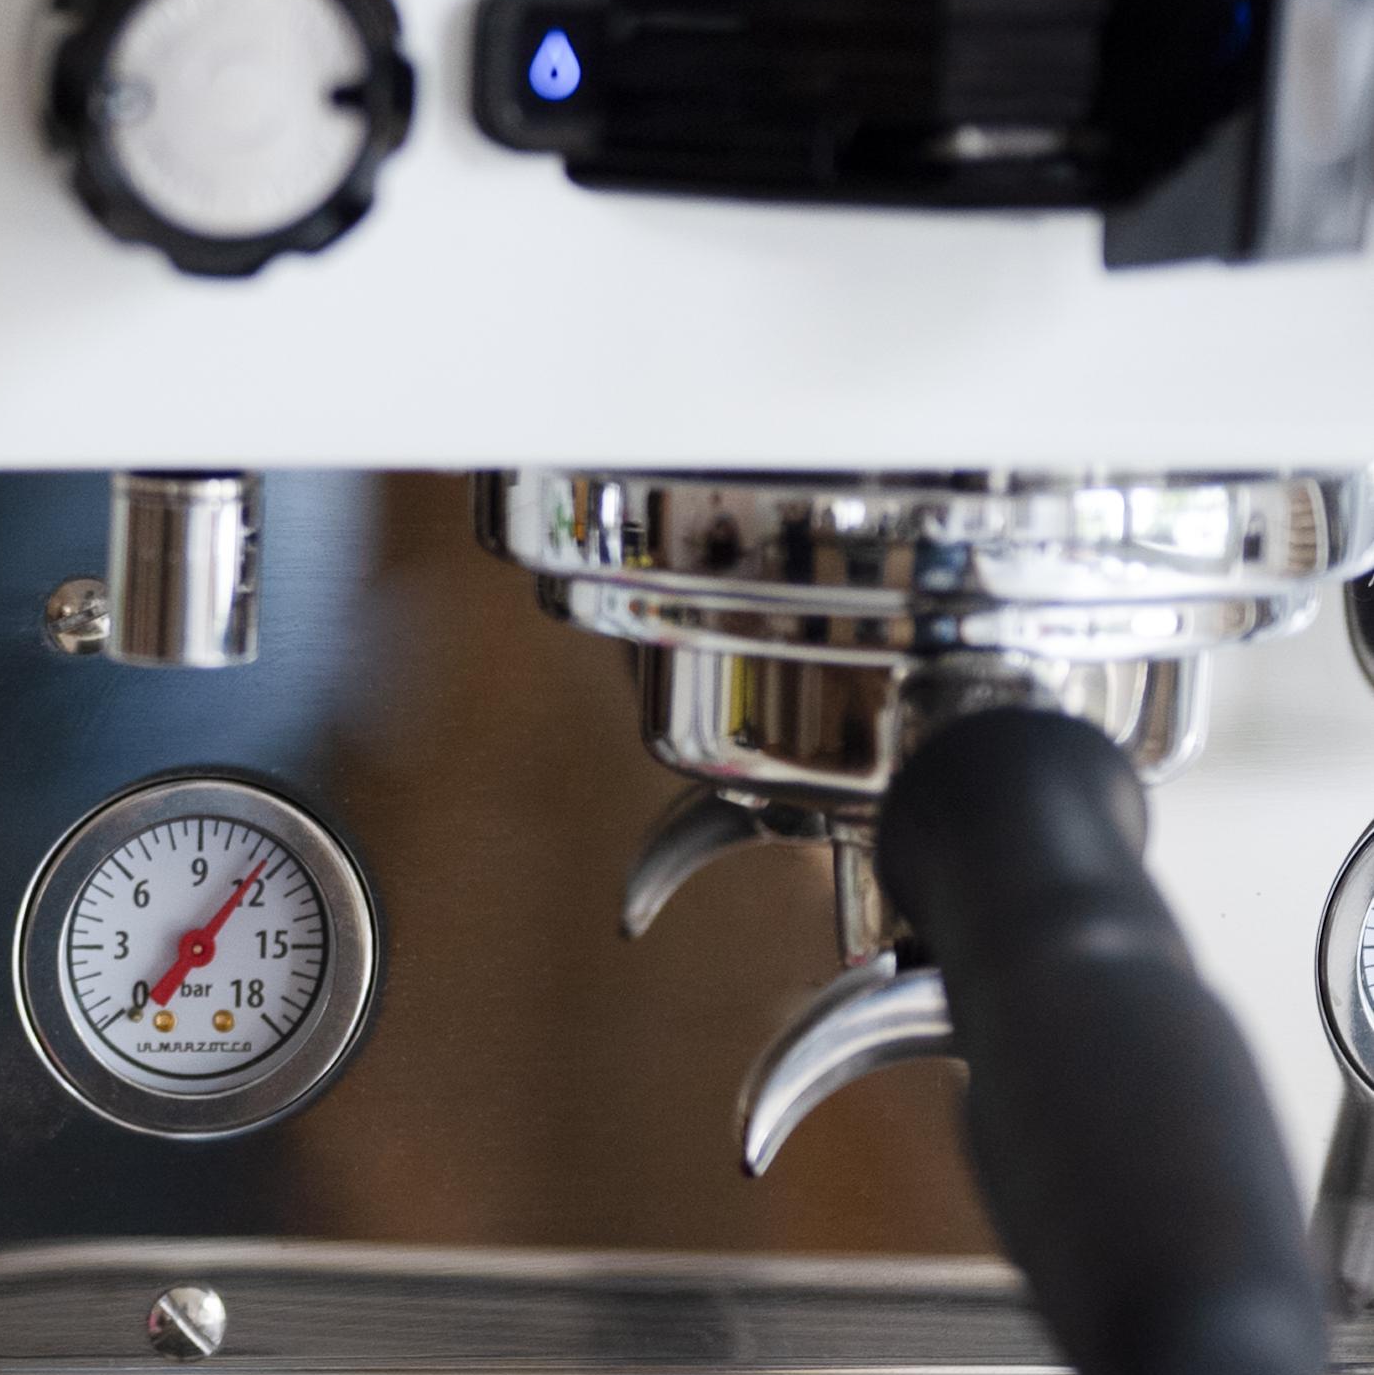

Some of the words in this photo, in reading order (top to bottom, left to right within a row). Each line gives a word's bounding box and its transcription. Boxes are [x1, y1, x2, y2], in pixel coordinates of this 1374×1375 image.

[191, 857, 209, 887] 9
[133, 879, 150, 908] 6
[113, 930, 130, 960] 3
[255, 929, 289, 960] 15
[132, 980, 149, 1009] 0
[180, 979, 213, 997] bar
[230, 978, 265, 1009] 18
